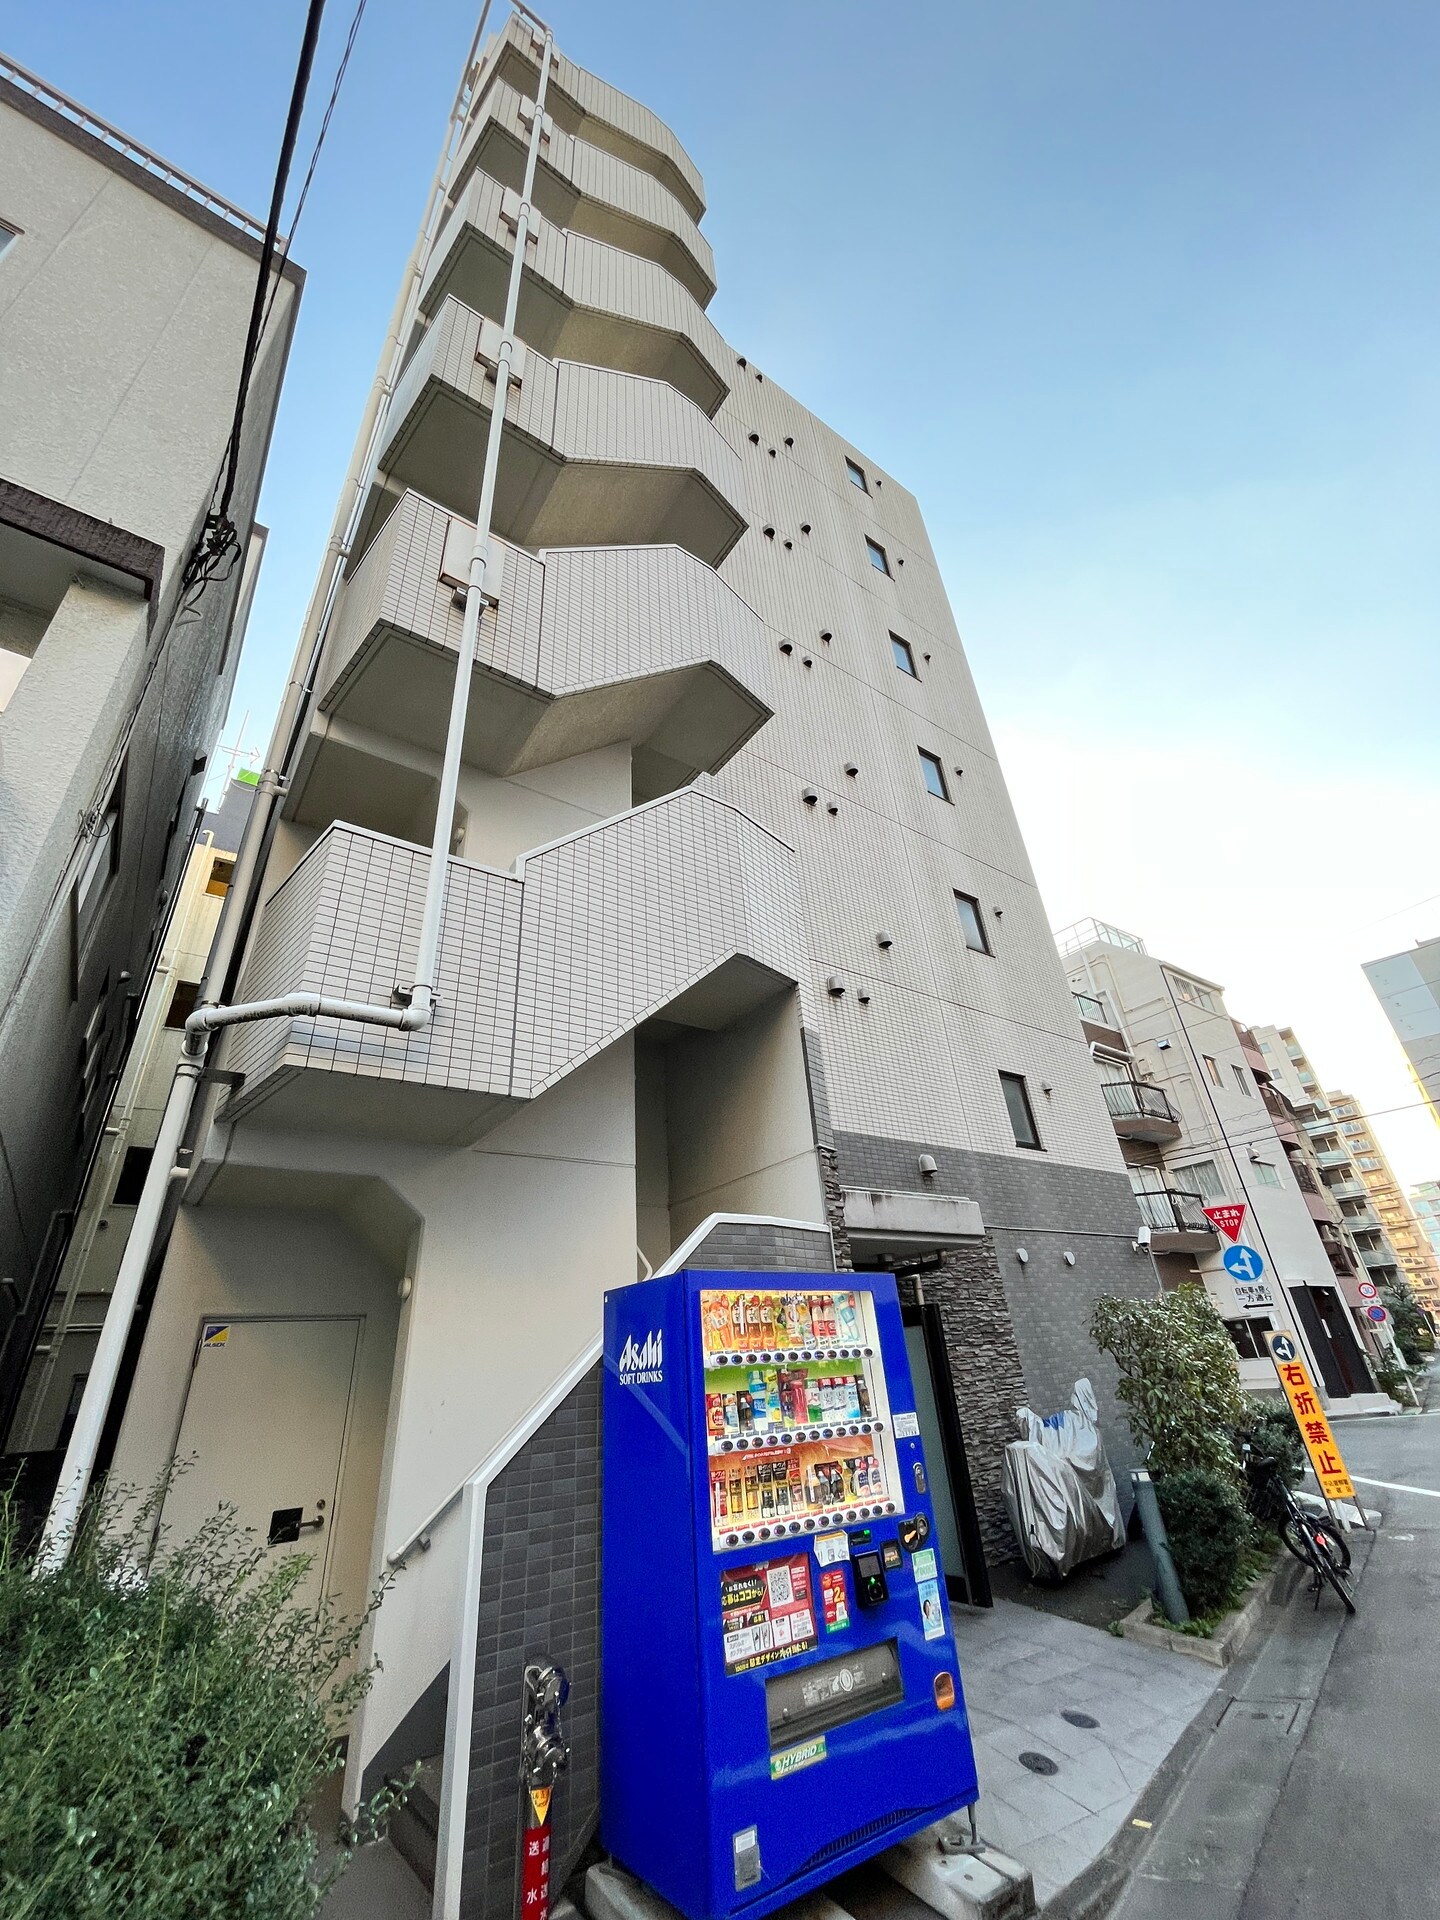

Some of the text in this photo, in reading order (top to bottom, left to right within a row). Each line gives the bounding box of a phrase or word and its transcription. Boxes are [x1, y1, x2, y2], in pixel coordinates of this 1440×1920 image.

[1213, 1208, 1240, 1219] 止まれ
[1220, 1218, 1239, 1228] STOP
[1238, 1294, 1272, 1302] 一方通行
[619, 1328, 662, 1372] Asahi
[620, 1370, 662, 1386] SOFT DRINKS
[1283, 1364, 1341, 1475] 右折禁止
[782, 1744, 817, 1770] HYBRID
